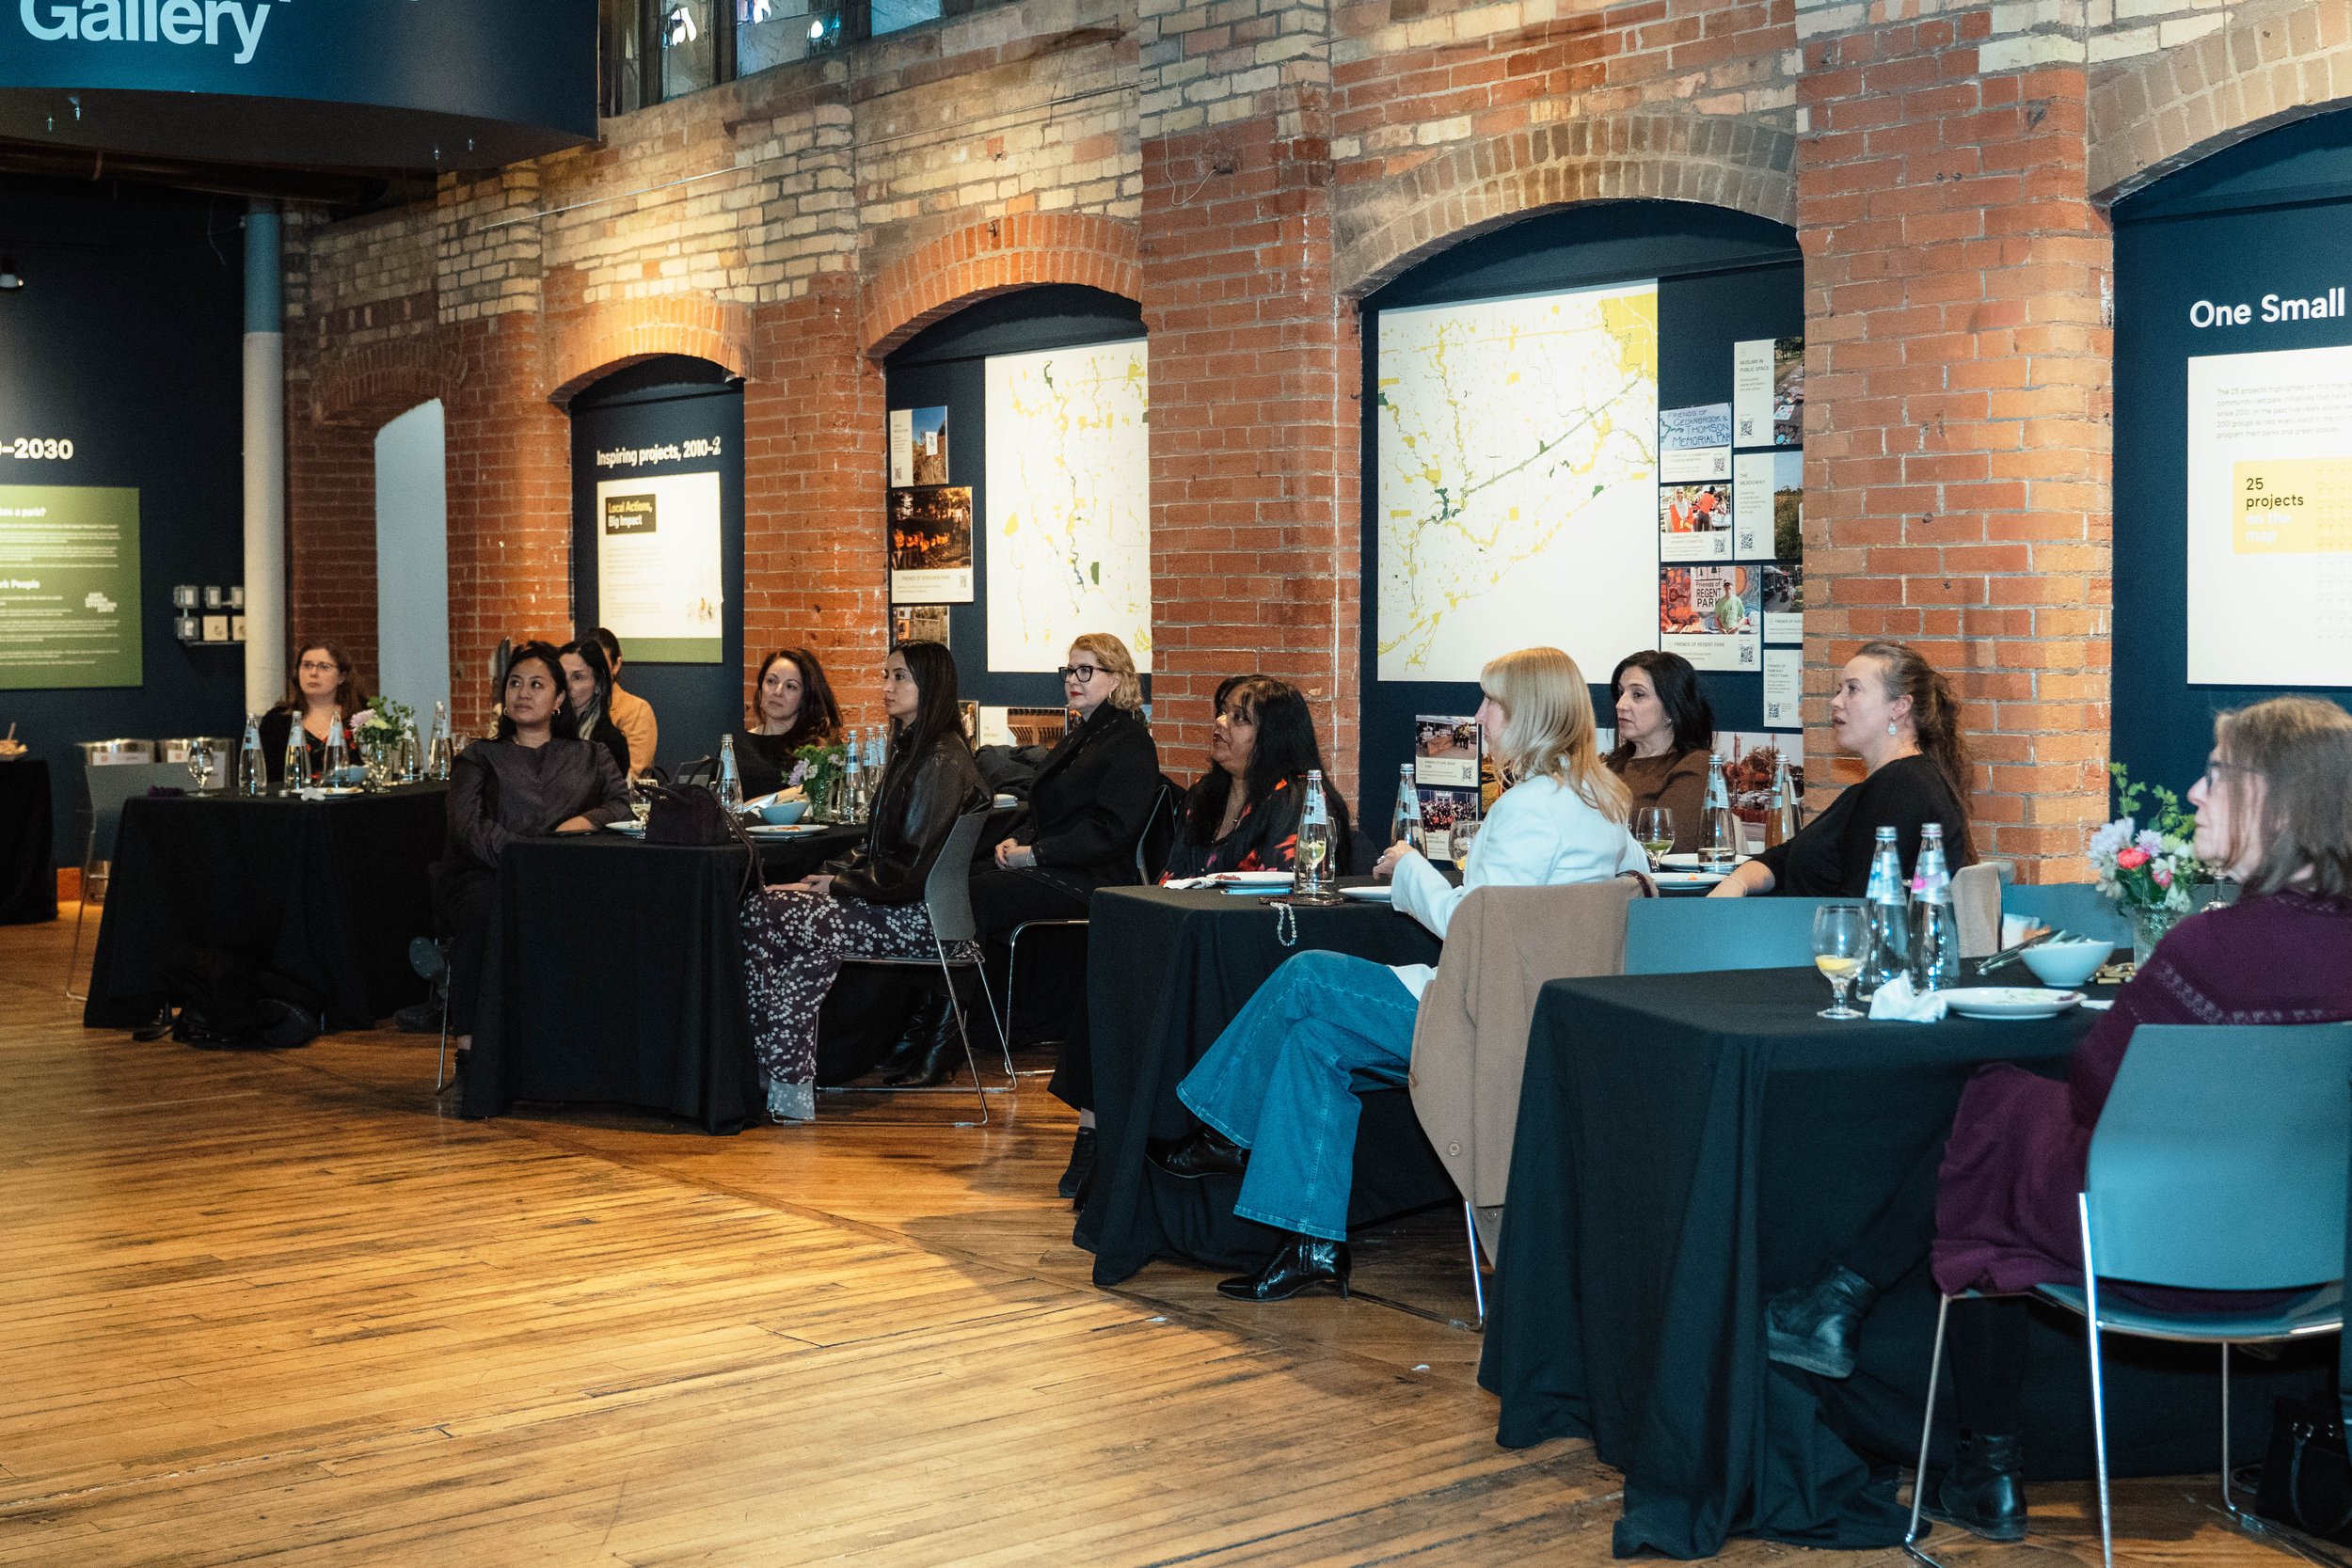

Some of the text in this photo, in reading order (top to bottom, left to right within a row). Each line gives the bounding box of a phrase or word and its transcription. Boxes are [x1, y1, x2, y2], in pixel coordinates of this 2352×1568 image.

[20, 0, 271, 65] Gallery
[2189, 287, 2345, 328] One Small
[1668, 410, 1697, 419] FRIENDS
[1673, 416, 1721, 427] CEDARBROOK
[1685, 423, 1730, 435] THOMSON
[1672, 436, 1716, 448] MEMORIAL
[596, 446, 638, 469] Inspiring
[638, 443, 682, 466] projects,
[2246, 477, 2264, 491] 25
[608, 501, 625, 515] Local
[2246, 493, 2304, 511] projects
[608, 514, 643, 530] Big Impact
[2246, 511, 2292, 526] on the
[2246, 531, 2277, 546] map
[1696, 588, 1722, 598] REGENT
[1696, 598, 1721, 608] PARK
